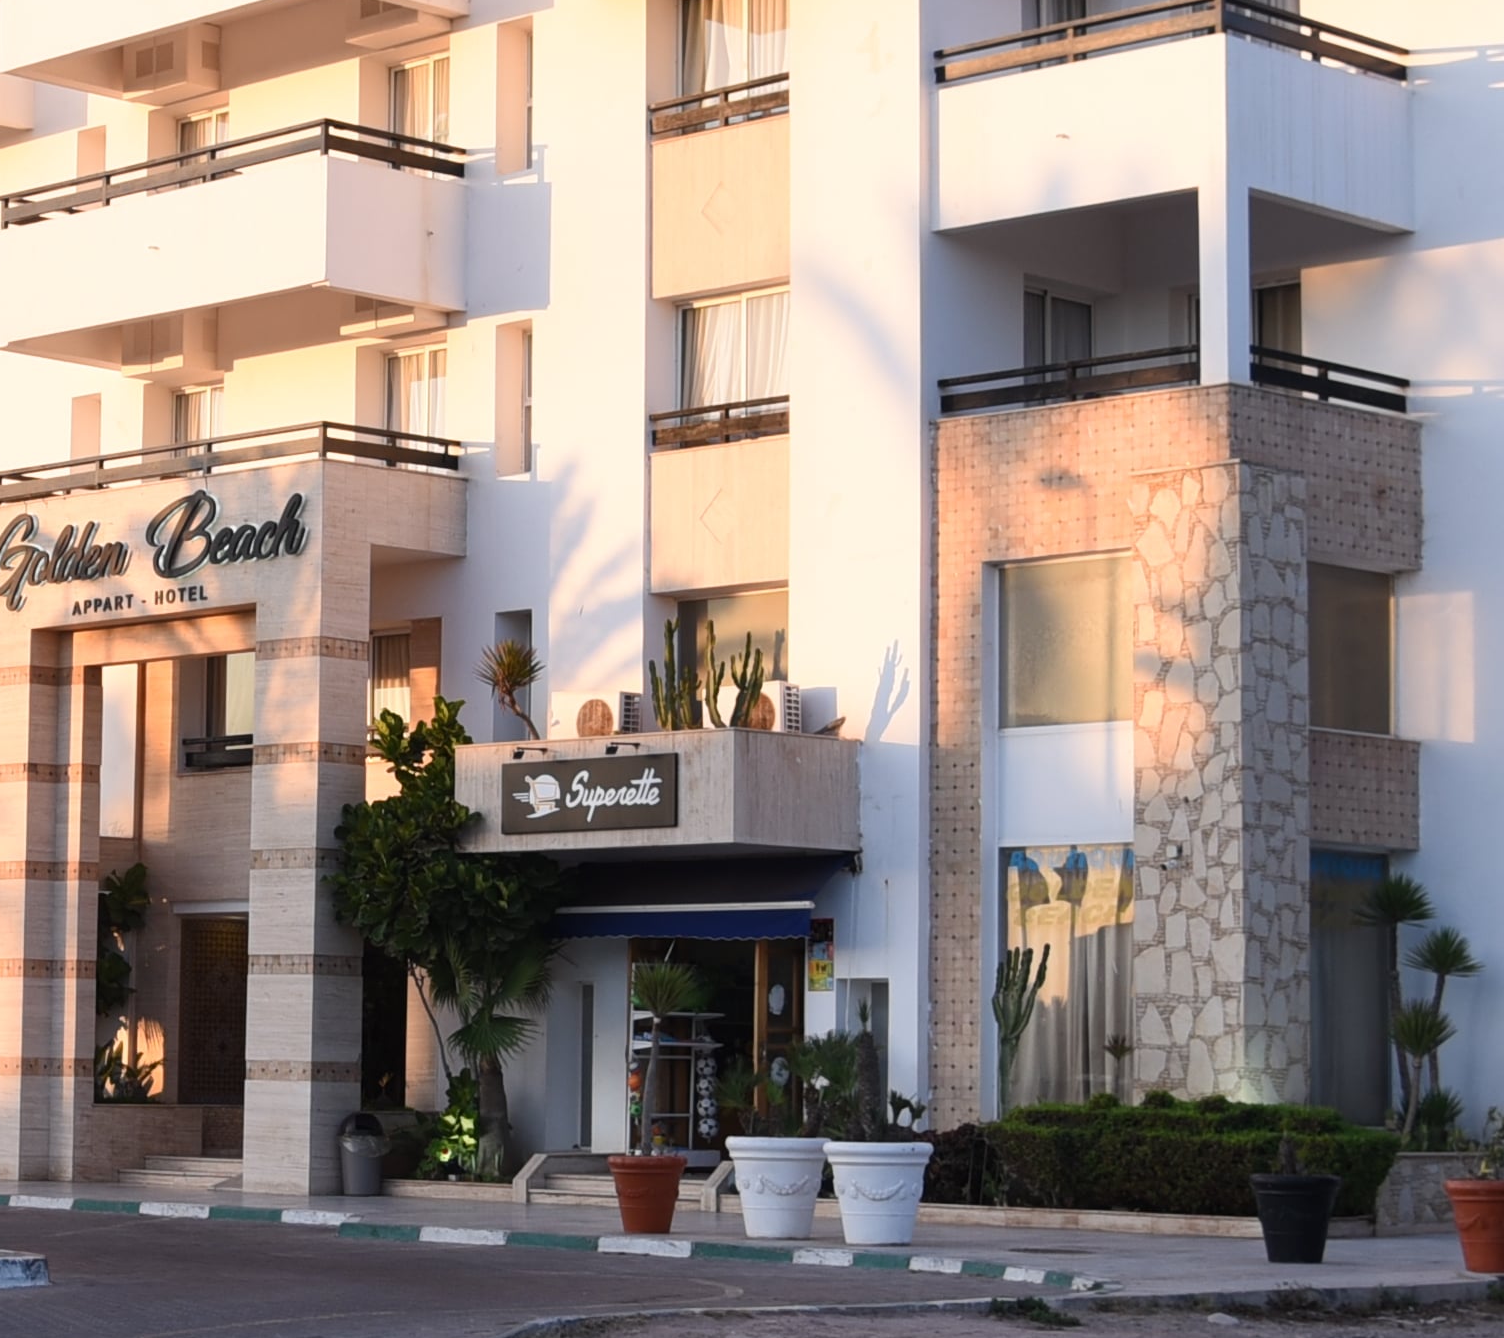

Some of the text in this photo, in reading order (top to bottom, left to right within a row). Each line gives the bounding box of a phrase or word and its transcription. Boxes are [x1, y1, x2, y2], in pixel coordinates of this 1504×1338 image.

[144, 488, 308, 580] Beach
[72, 593, 134, 616] APPART
[154, 585, 209, 606] HOTEL
[565, 767, 663, 823] Superette
